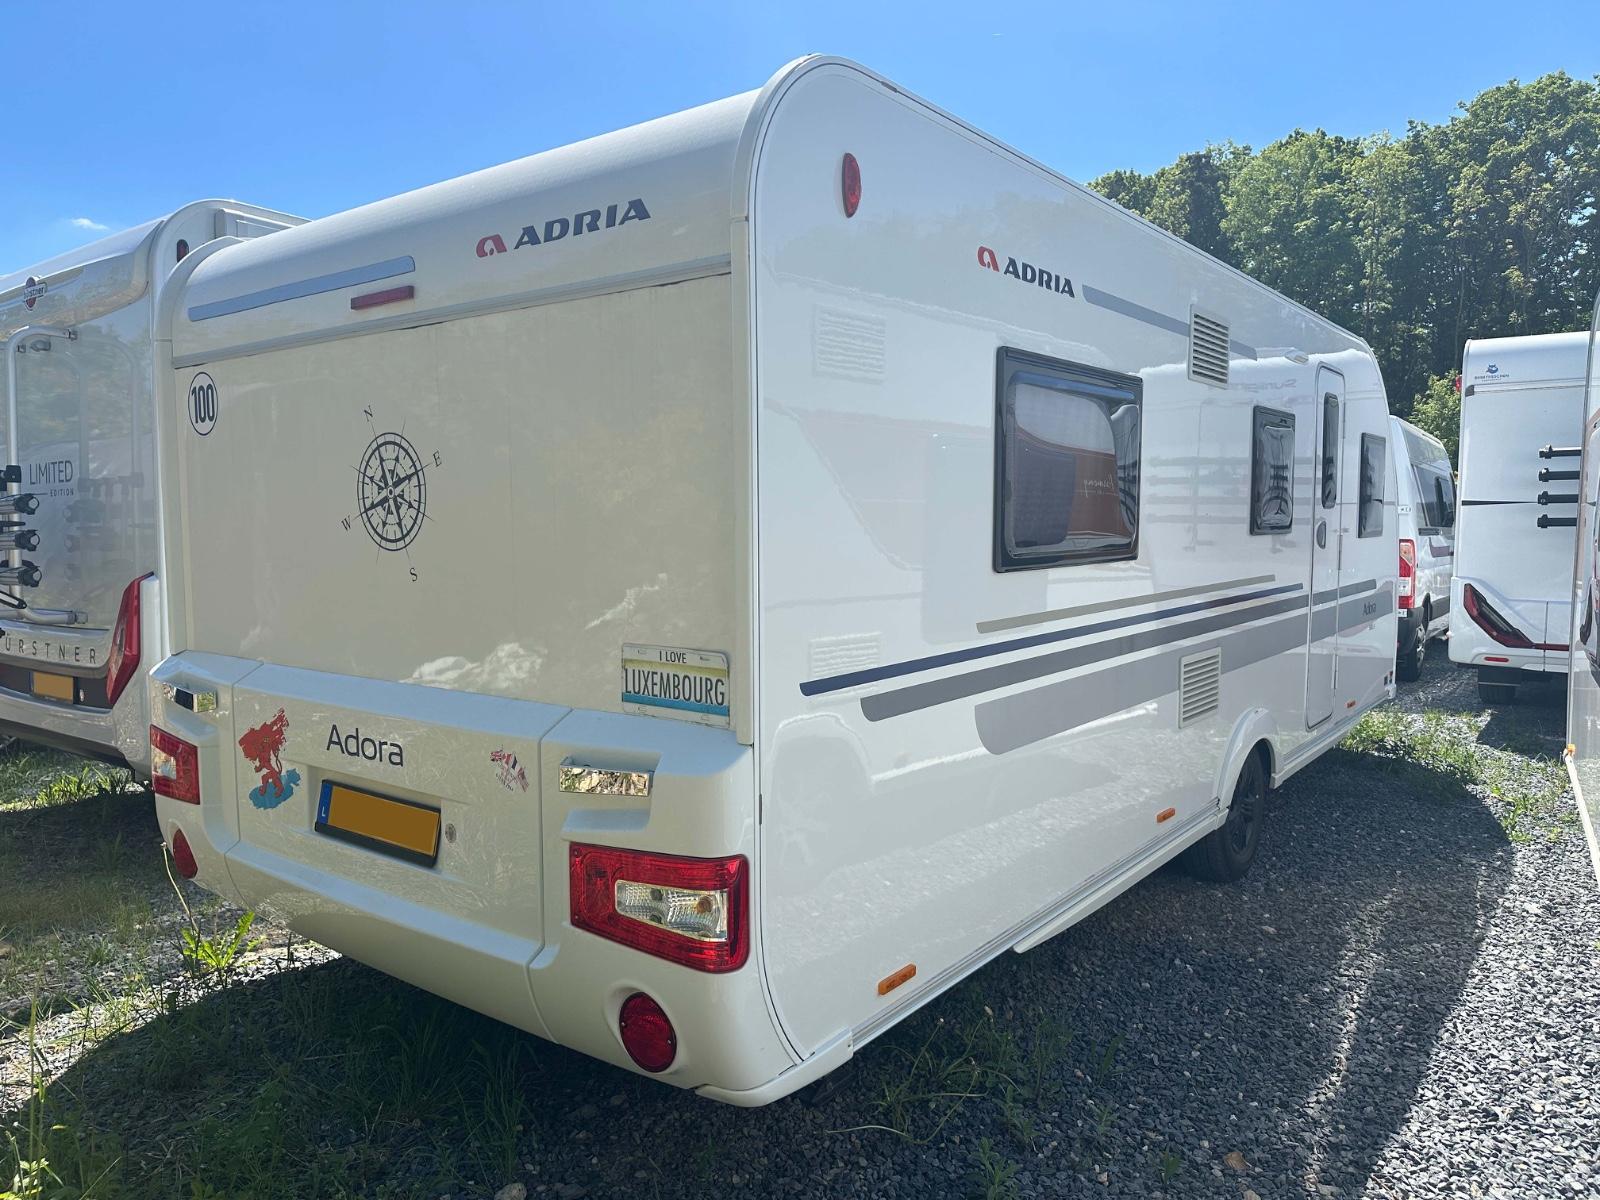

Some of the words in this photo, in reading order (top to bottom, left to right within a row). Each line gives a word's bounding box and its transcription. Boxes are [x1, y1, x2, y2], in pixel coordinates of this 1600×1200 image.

[513, 198, 652, 250] ADRIA
[1003, 256, 1075, 299] ADRIA
[191, 383, 215, 424] 100
[363, 404, 374, 422] N
[432, 450, 443, 468] E
[29, 460, 74, 485] LIMITED
[50, 487, 75, 497] EDITION
[340, 514, 353, 532] W
[409, 567, 418, 582] S
[665, 651, 688, 664] LOVE
[624, 668, 726, 706] LUXEMBOURG
[326, 723, 404, 767] Adora
